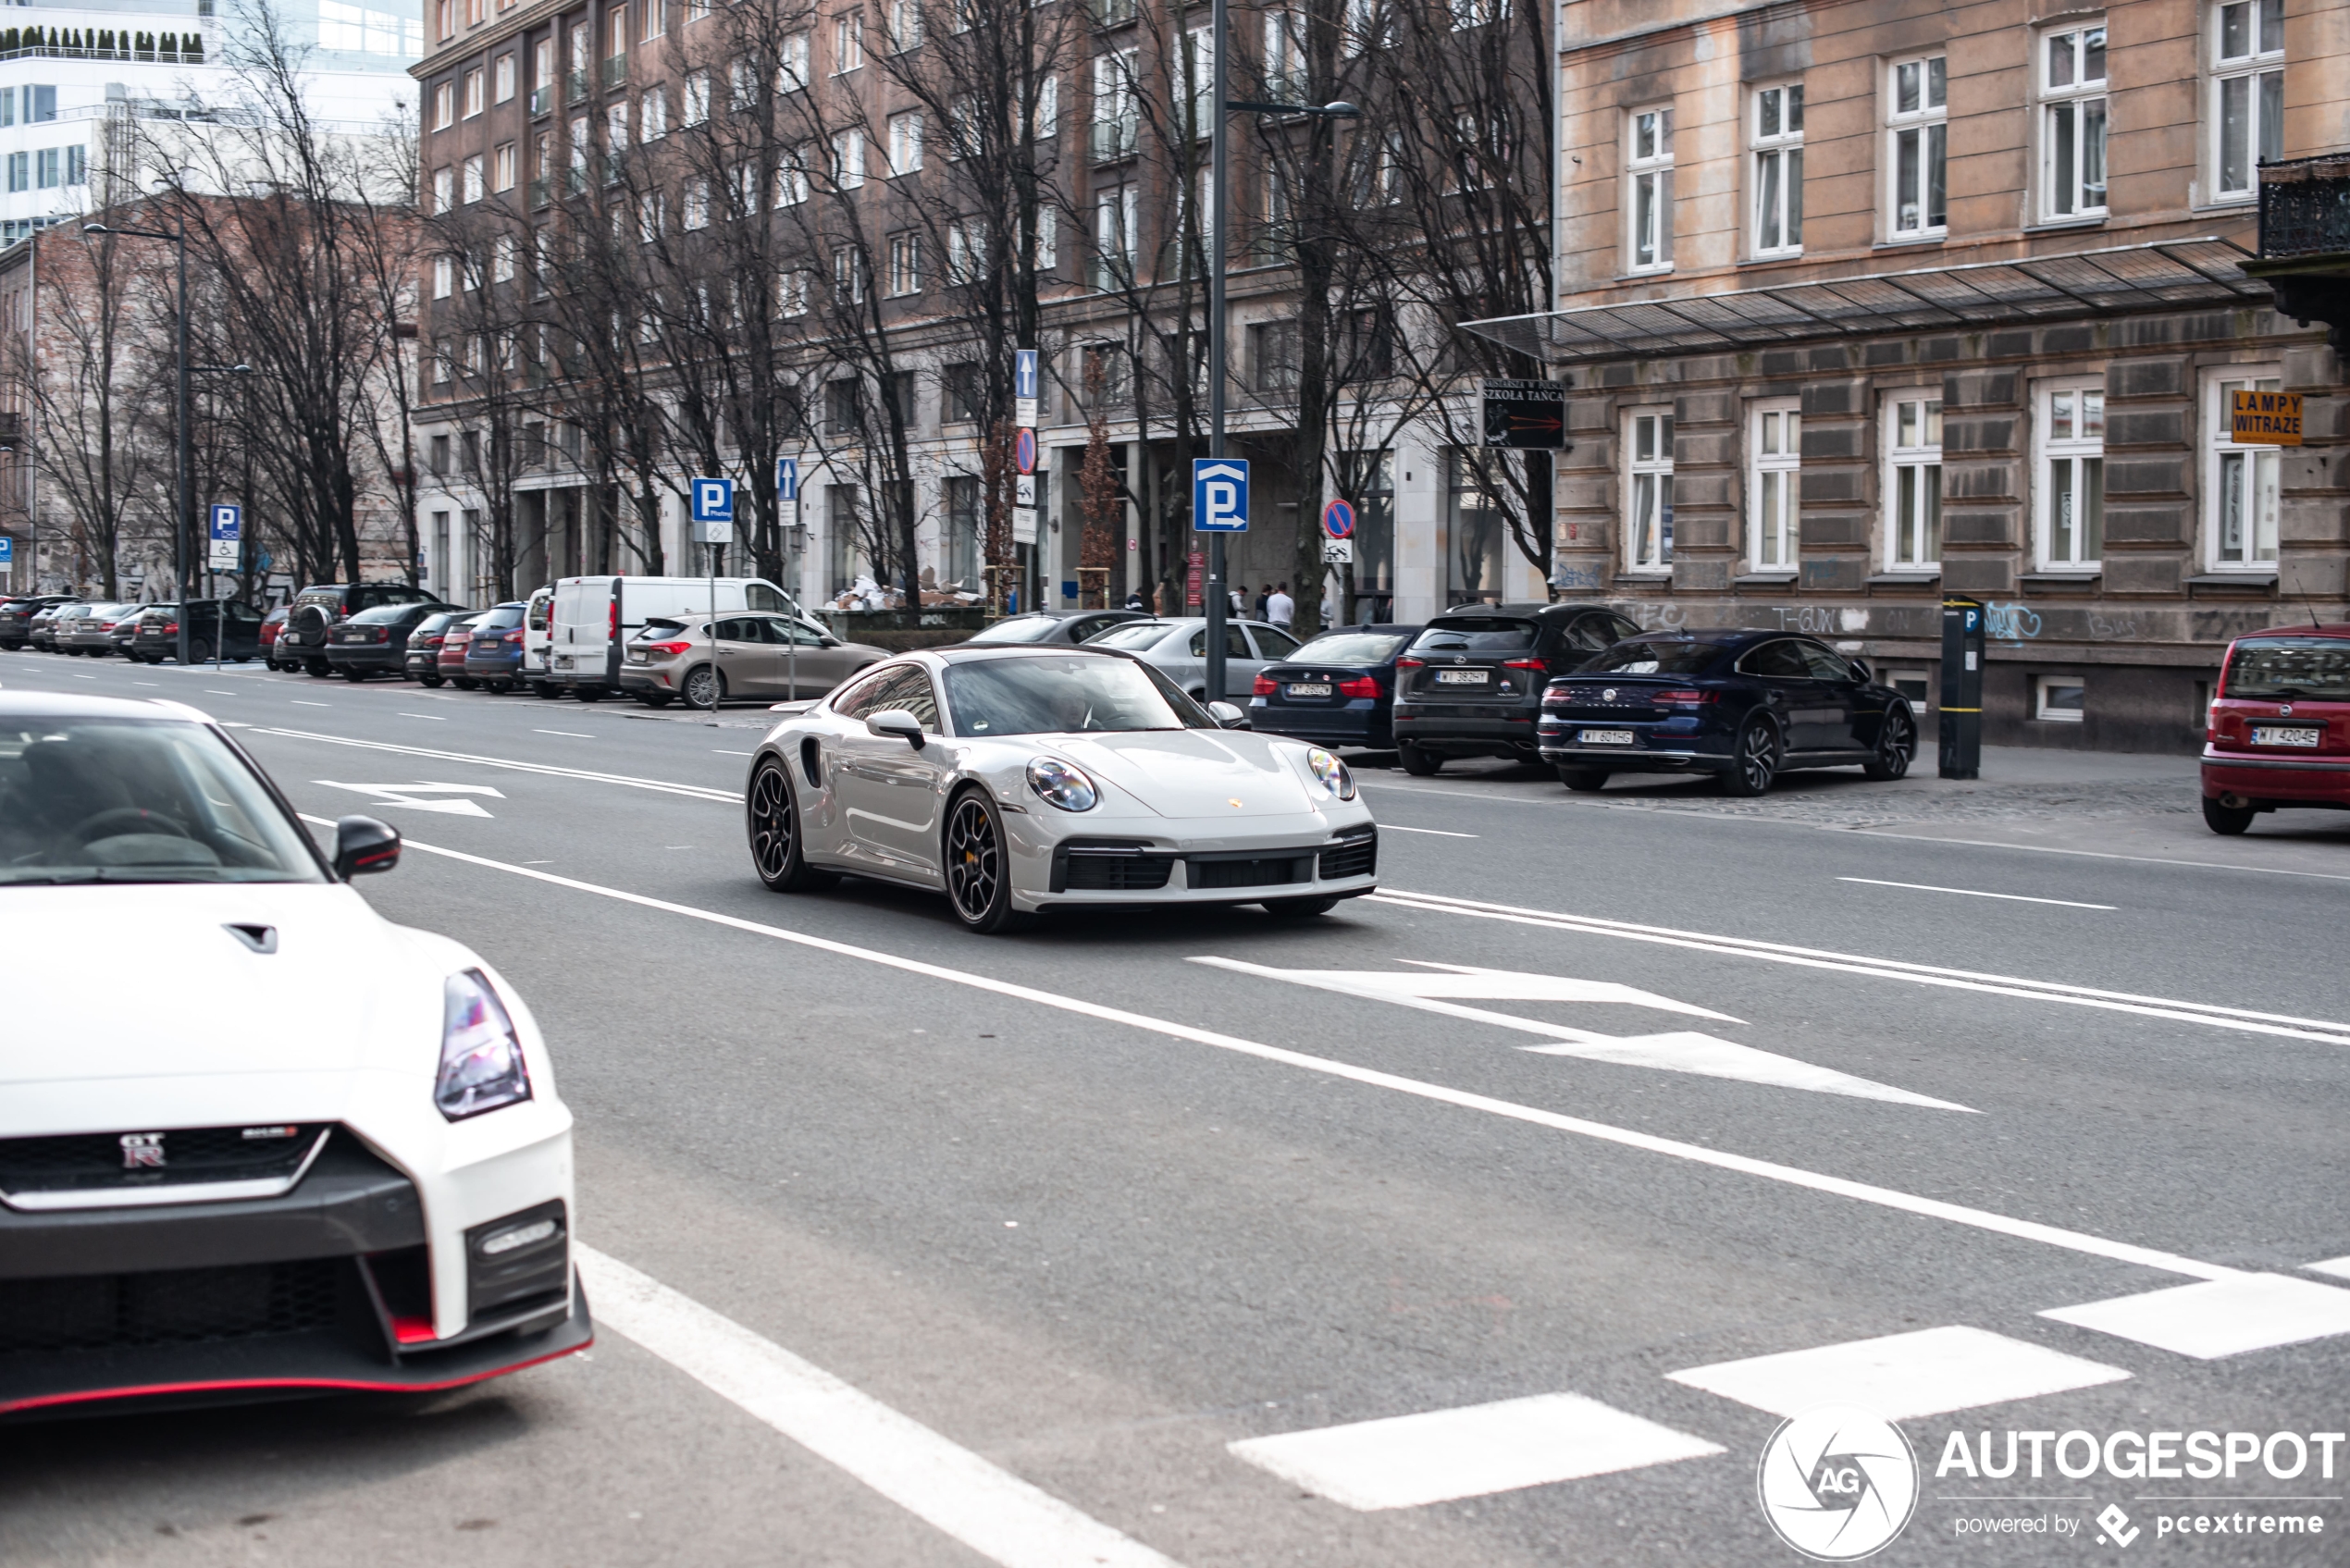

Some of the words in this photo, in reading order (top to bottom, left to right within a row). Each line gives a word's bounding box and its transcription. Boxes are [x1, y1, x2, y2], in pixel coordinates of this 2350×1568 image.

[1528, 380, 1535, 389] W
[1482, 389, 1525, 401] SZKOŁA
[1527, 389, 1565, 402] TAŃCA
[2235, 393, 2301, 414] LAMPY
[2235, 412, 2300, 435] WITRAŻE
[700, 483, 725, 516] P
[1206, 481, 1235, 525] P
[216, 507, 235, 531] P
[1966, 611, 1977, 628] P
[1441, 672, 1453, 682] WI
[1456, 672, 1486, 682] 382HY
[1583, 731, 1597, 742] WI
[1600, 731, 1631, 743] 601HG
[2258, 727, 2274, 741] WI
[2279, 729, 2317, 743] 4204E
